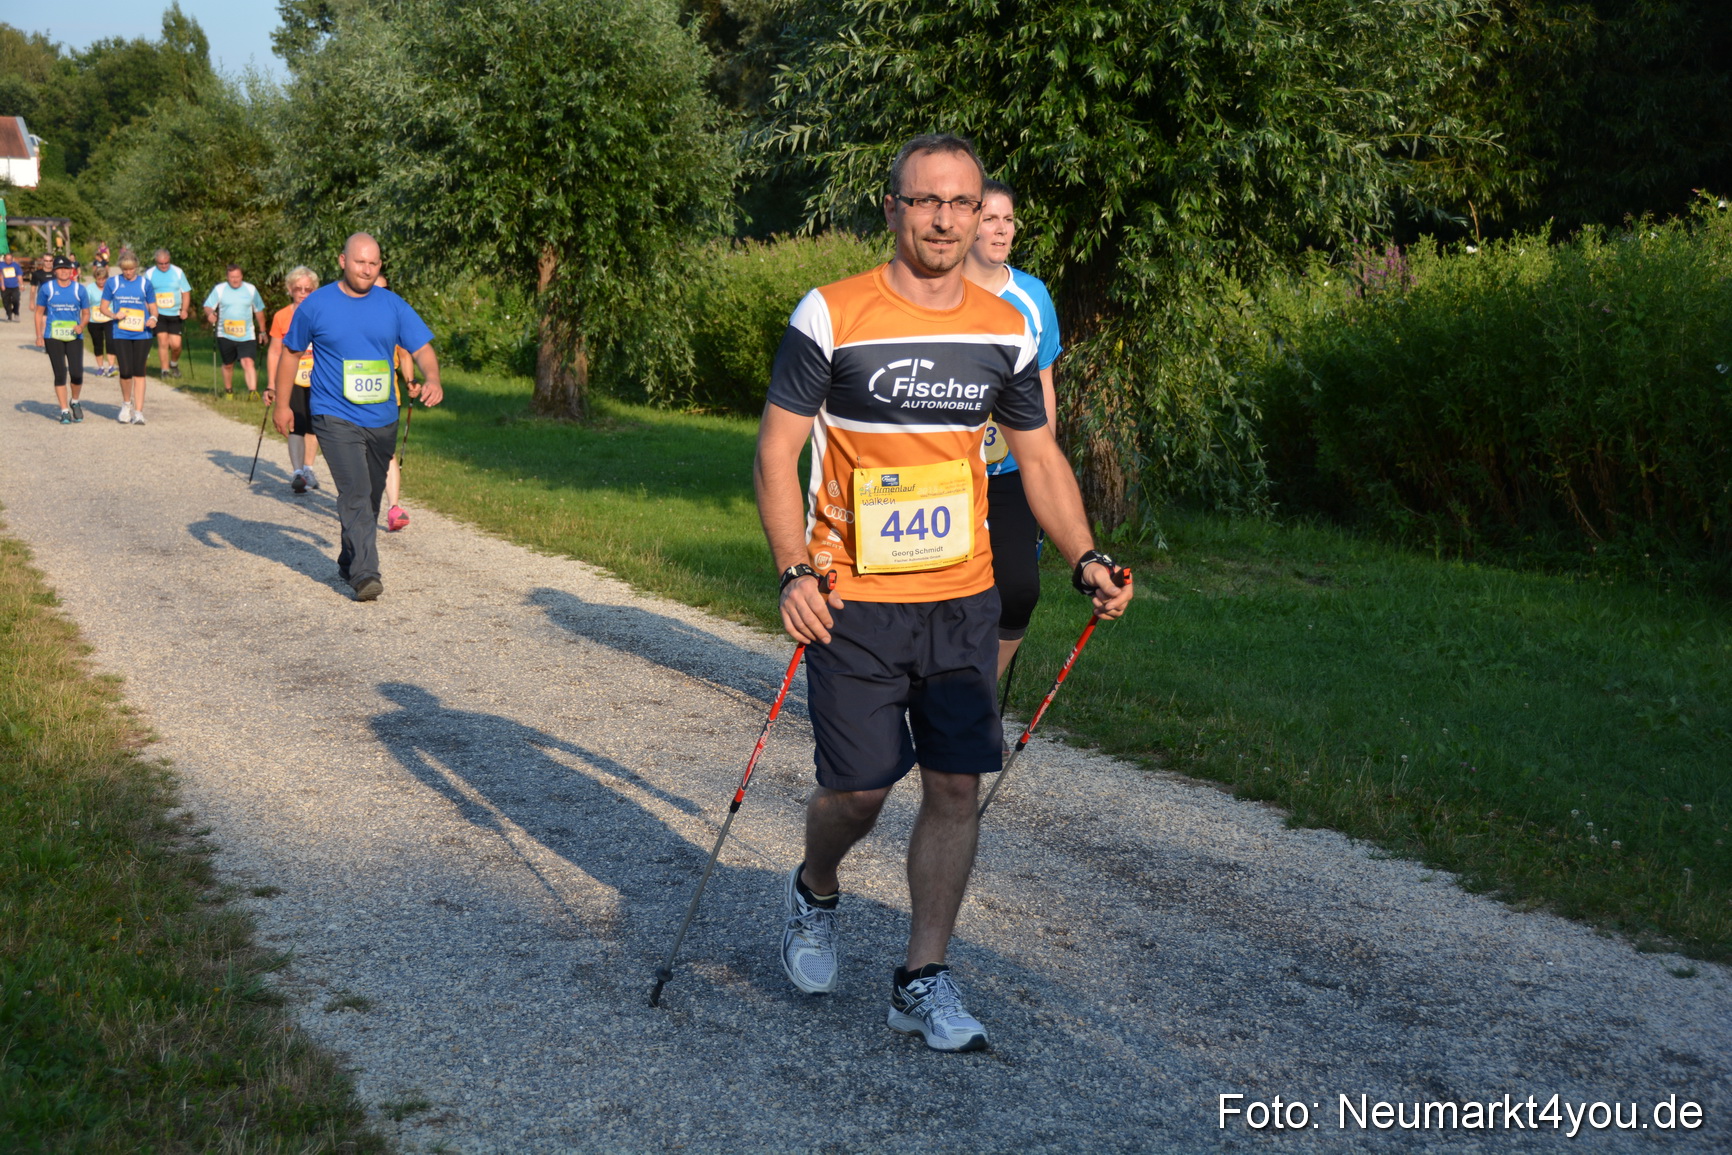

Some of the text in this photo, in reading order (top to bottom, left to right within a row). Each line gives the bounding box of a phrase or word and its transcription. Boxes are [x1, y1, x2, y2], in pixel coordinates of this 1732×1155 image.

[354, 378, 383, 392] 805
[891, 377, 990, 399] Fischer
[900, 401, 983, 411] AUTOMOBILE
[880, 506, 951, 542] 440
[914, 546, 944, 555] Schmidt
